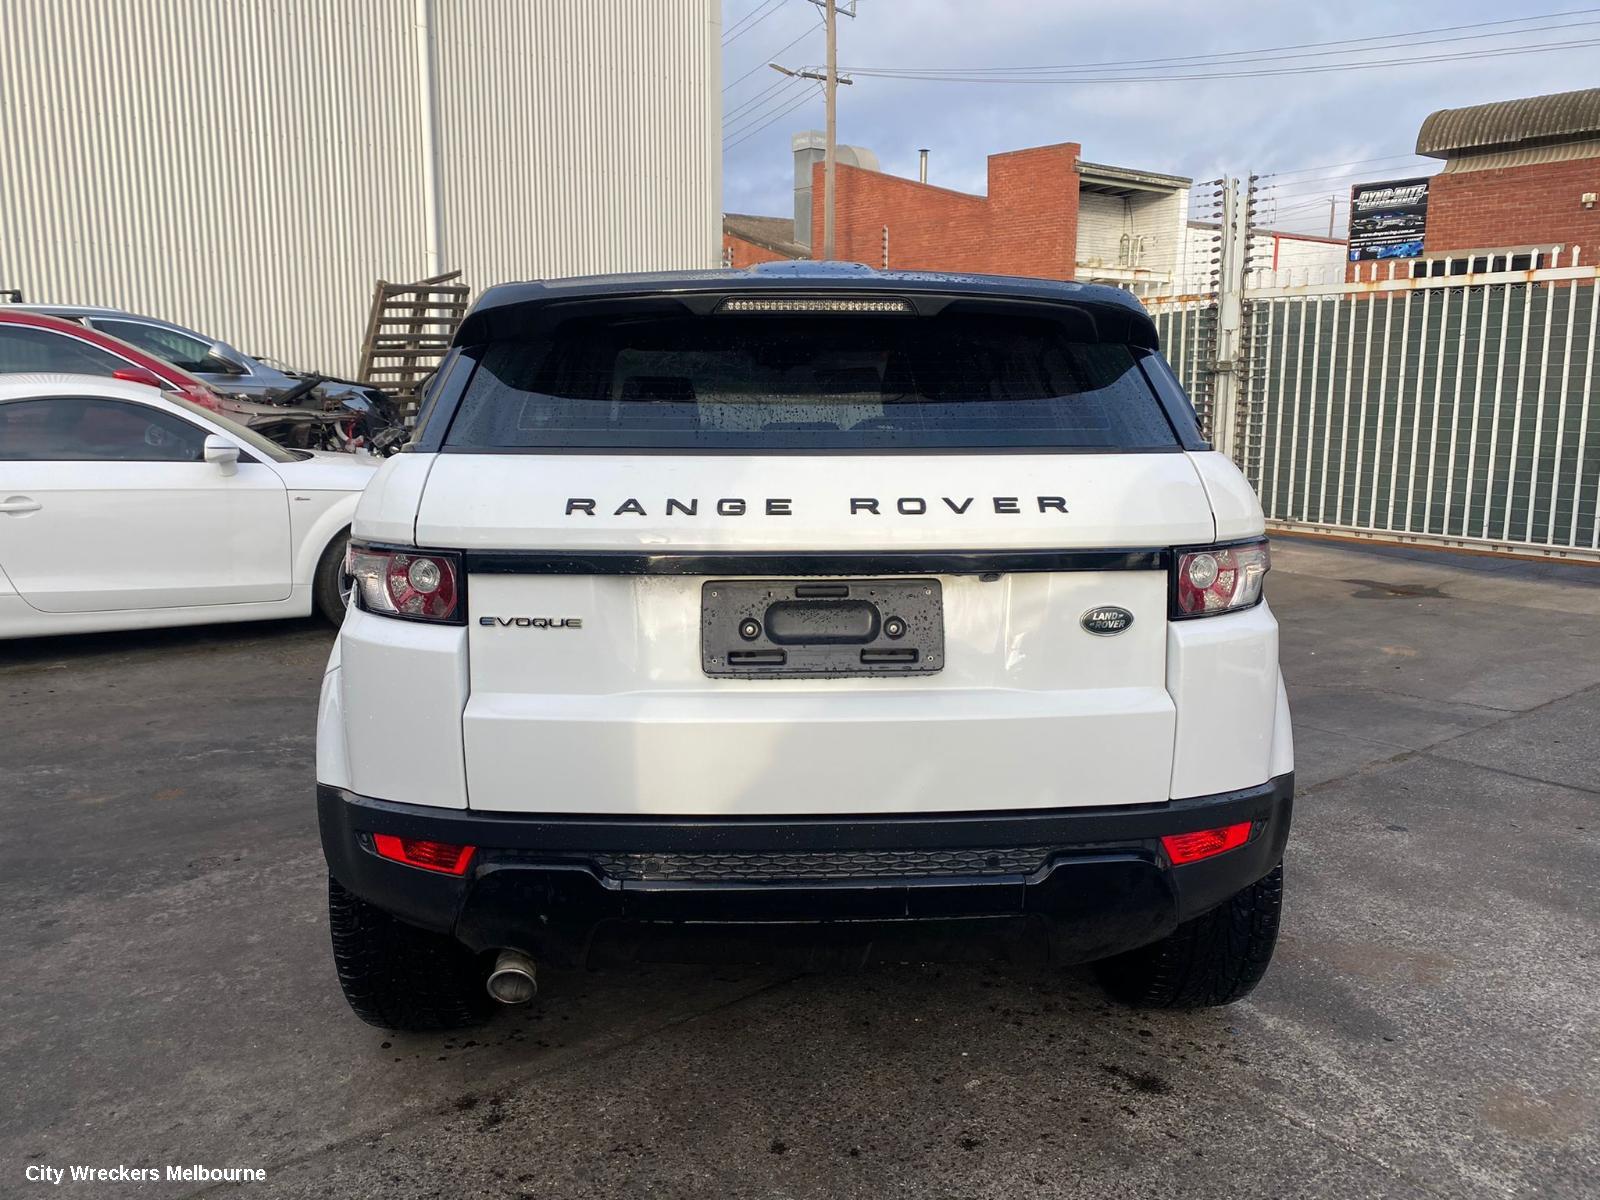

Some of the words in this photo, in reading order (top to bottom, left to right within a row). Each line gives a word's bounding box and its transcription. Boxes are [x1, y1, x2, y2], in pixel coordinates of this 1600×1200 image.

[565, 498, 792, 516] RANGE
[849, 496, 1069, 514] ROVER
[1093, 612, 1118, 621] LAND
[479, 616, 582, 629] EVOQUE
[1095, 620, 1126, 629] ROVER
